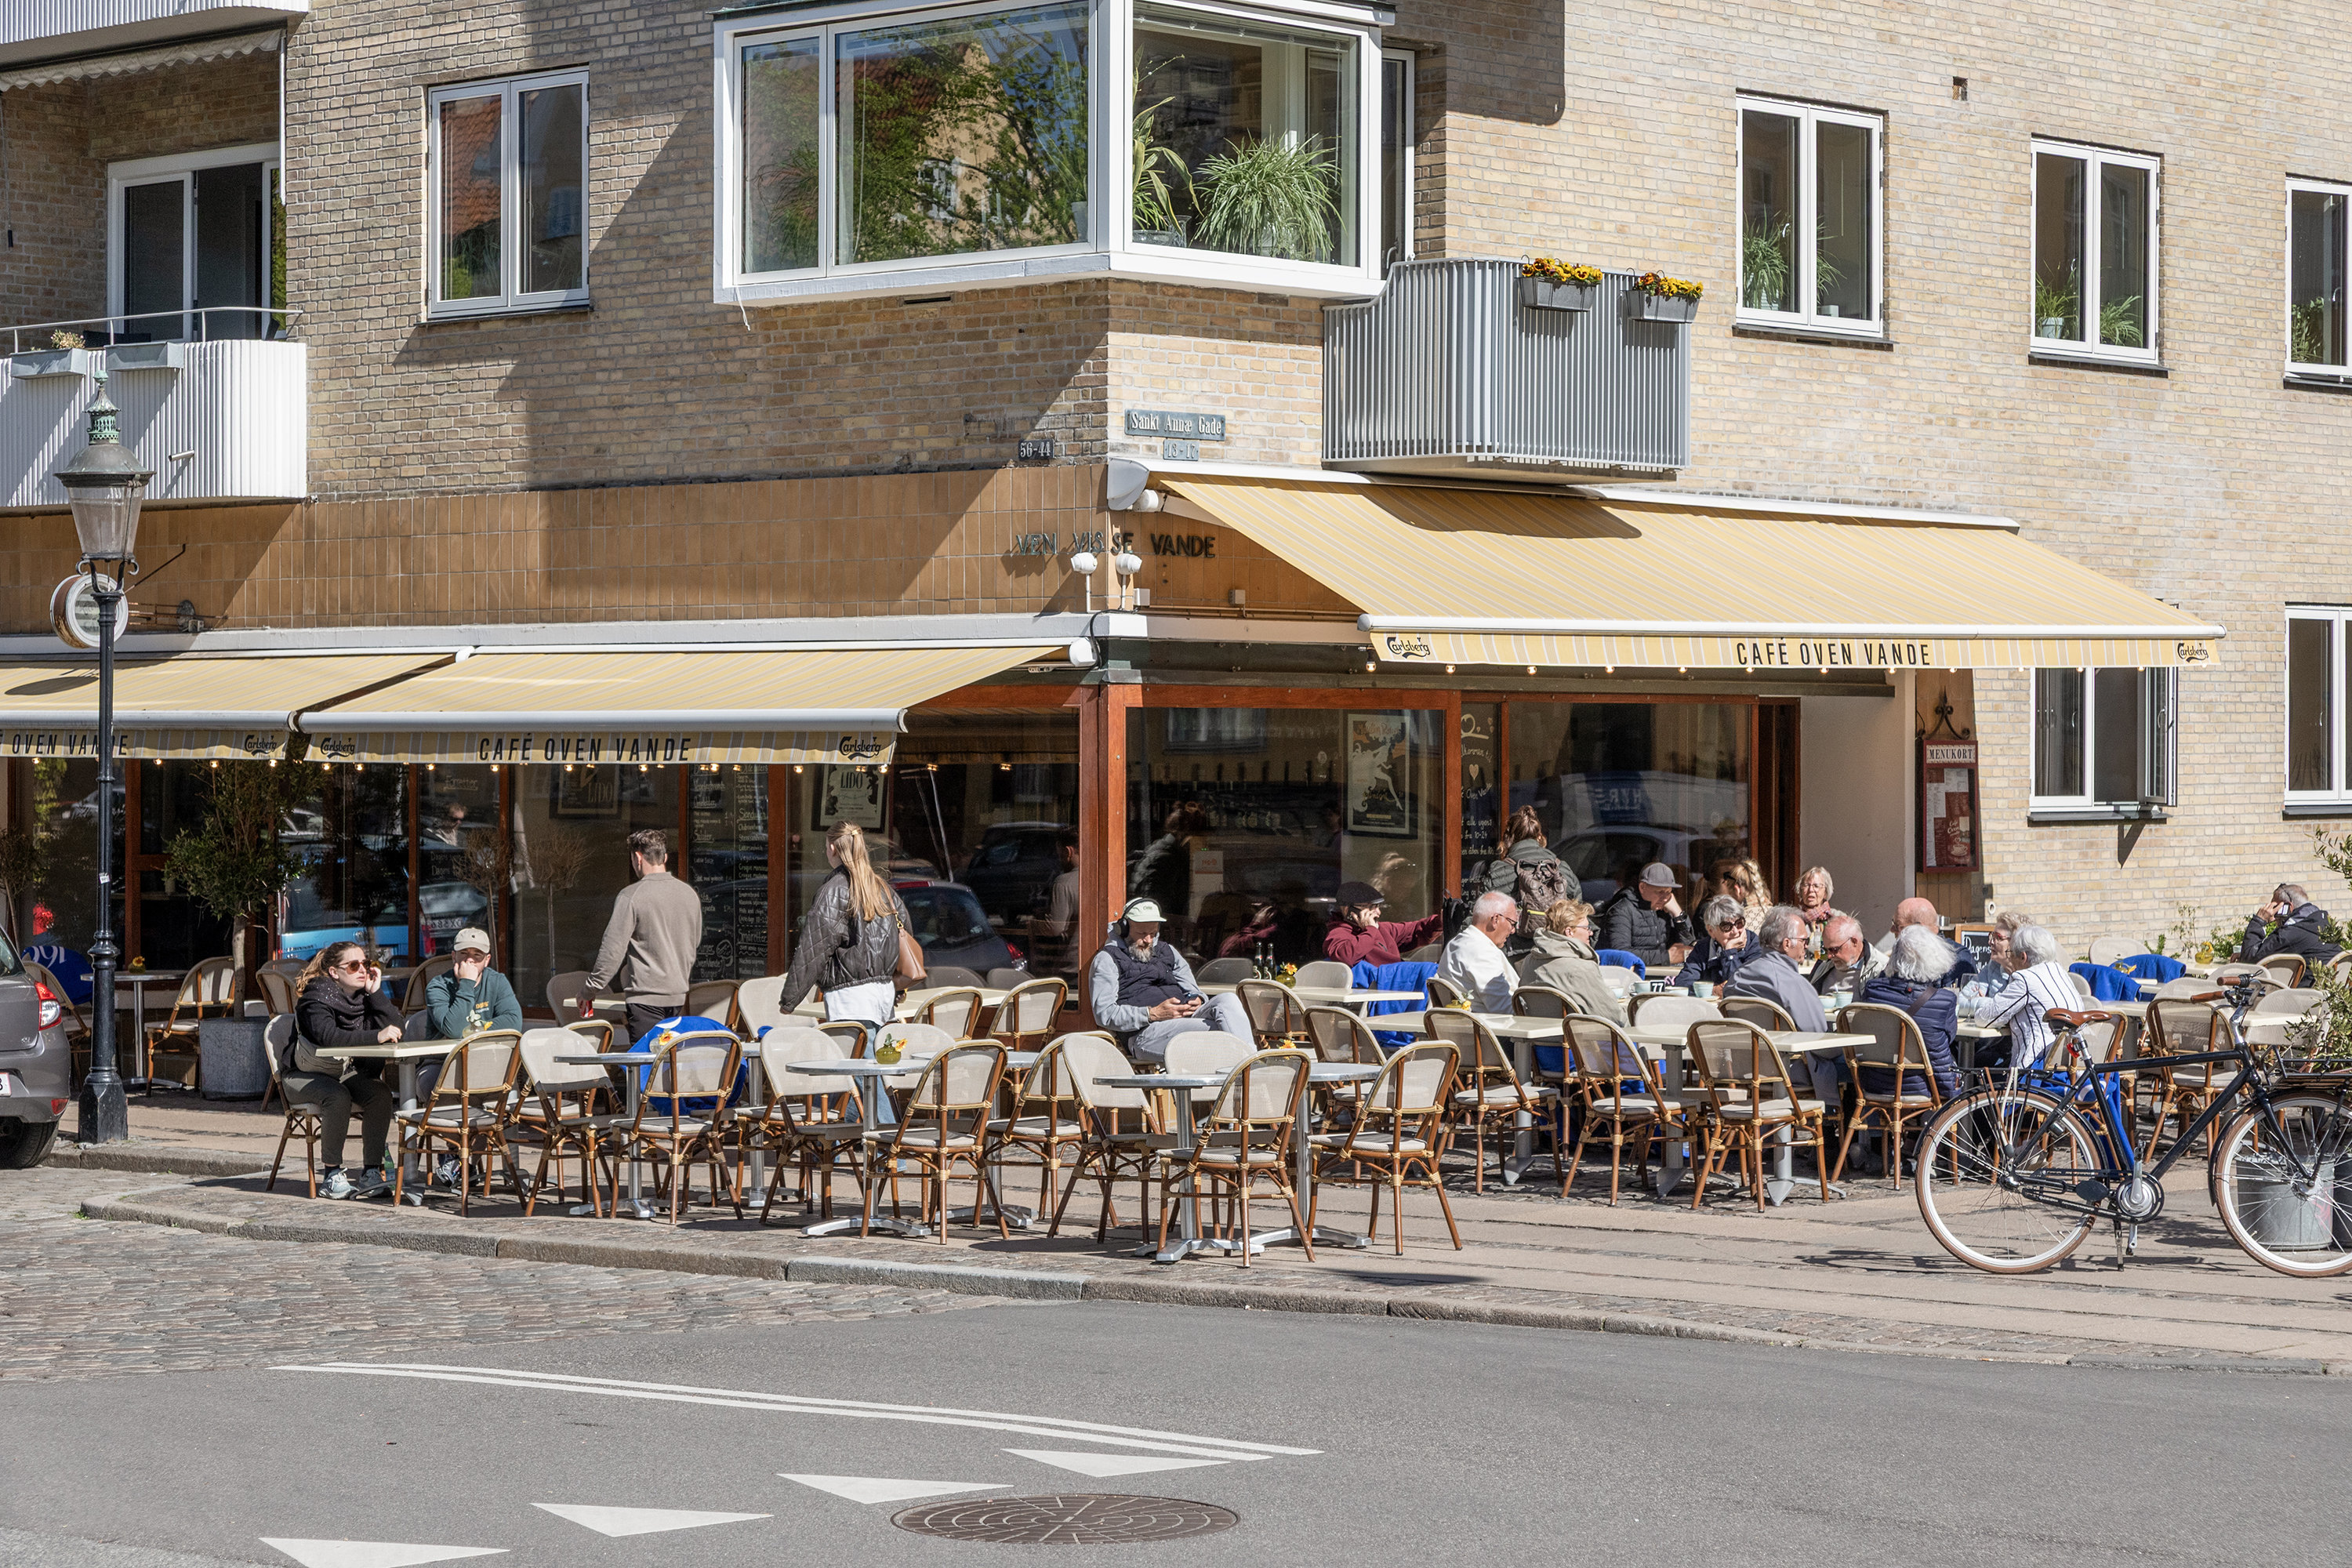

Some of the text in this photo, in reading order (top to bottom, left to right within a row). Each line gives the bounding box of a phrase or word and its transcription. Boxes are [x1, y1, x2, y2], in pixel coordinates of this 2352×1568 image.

[1131, 412, 1222, 435] Sankt Annæ Gade
[1020, 441, 1051, 458] 56-44
[1016, 532, 1058, 555] VEN
[1150, 532, 1215, 557] VANDE
[1387, 637, 1430, 655] Carlsberg
[1737, 637, 1930, 666] CAFÉ OVEN VANDE
[2177, 643, 2209, 659] Carlsberg
[12, 733, 58, 755] OVEN
[69, 734, 129, 756] VANE
[244, 734, 277, 753] Carlsberg
[321, 737, 355, 755] Carlsberg
[479, 732, 691, 761] CAFÉ OVEN VANDE
[839, 736, 881, 756] Carlsberg
[1929, 749, 1973, 760] MENUKORT
[840, 771, 863, 789] LIDO
[1965, 936, 1992, 961] Dagens
[1652, 982, 1664, 993] 77
